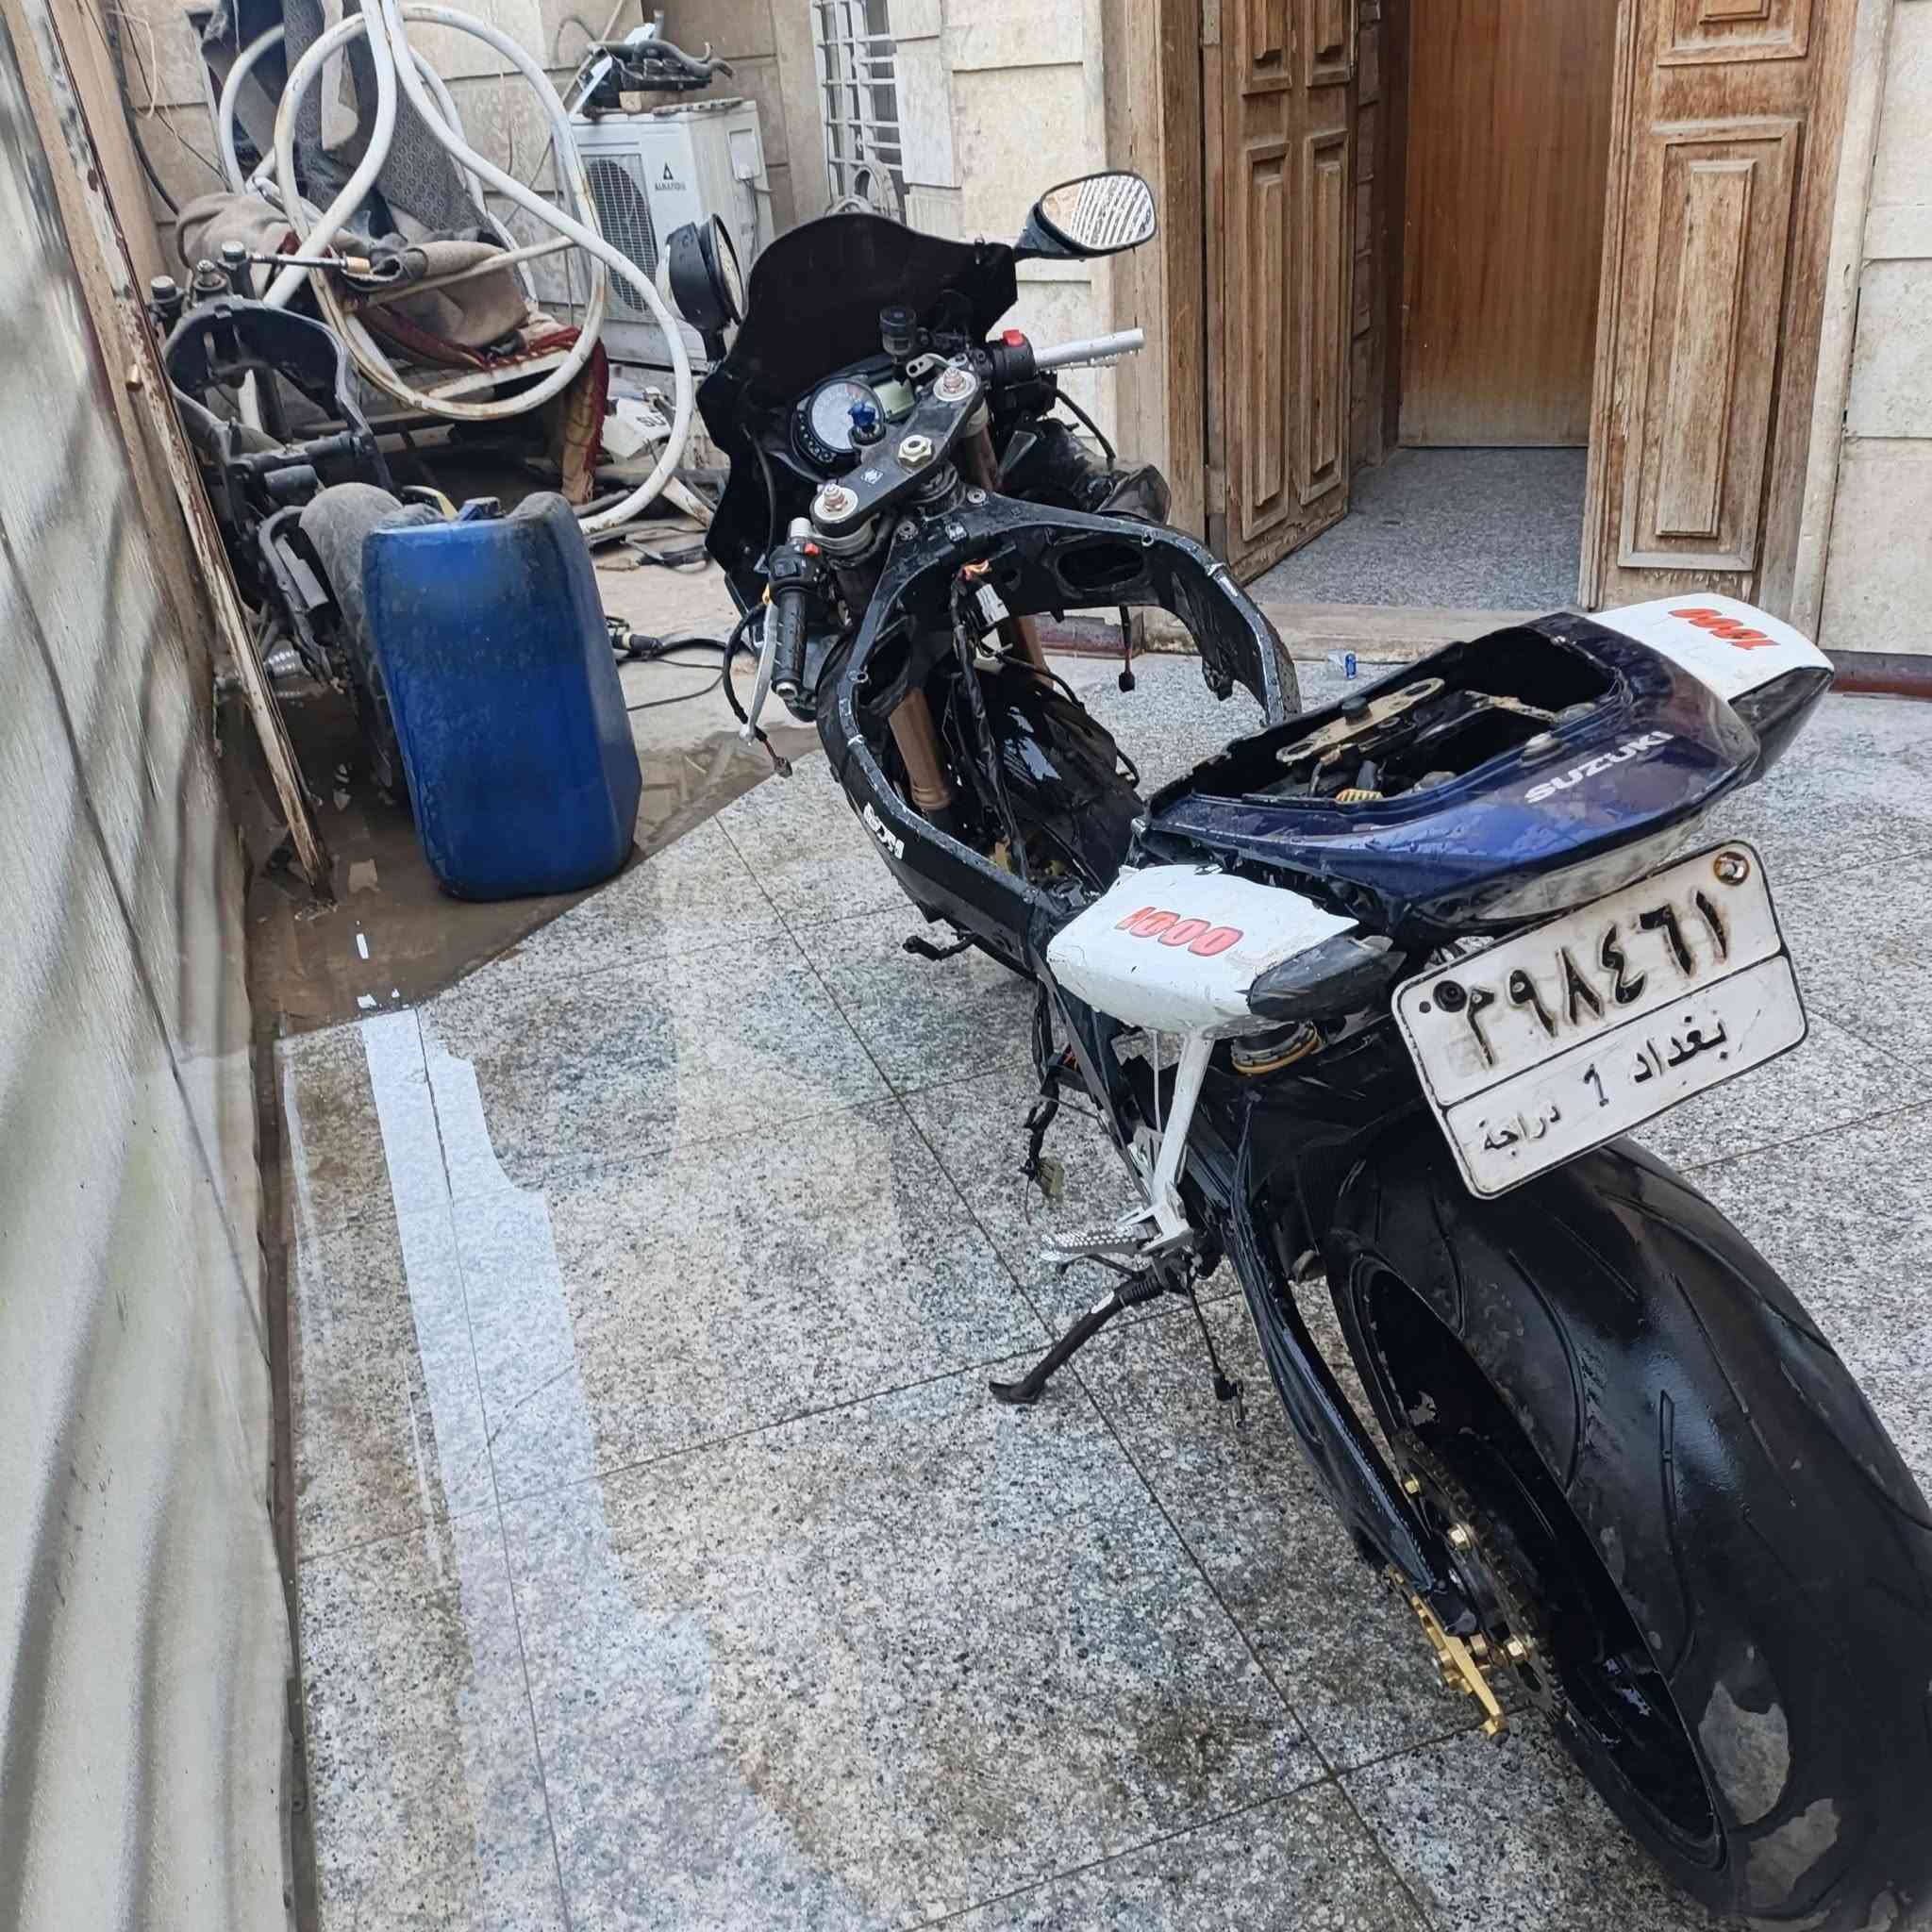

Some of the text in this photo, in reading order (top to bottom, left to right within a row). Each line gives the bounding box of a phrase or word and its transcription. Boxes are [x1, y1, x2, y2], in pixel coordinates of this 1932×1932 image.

[1524, 730, 1674, 803] SUZUKI
[1115, 906, 1244, 957] 1000
[1634, 1015, 1727, 1083] بغداد
[1478, 1105, 1561, 1157] دراجة
